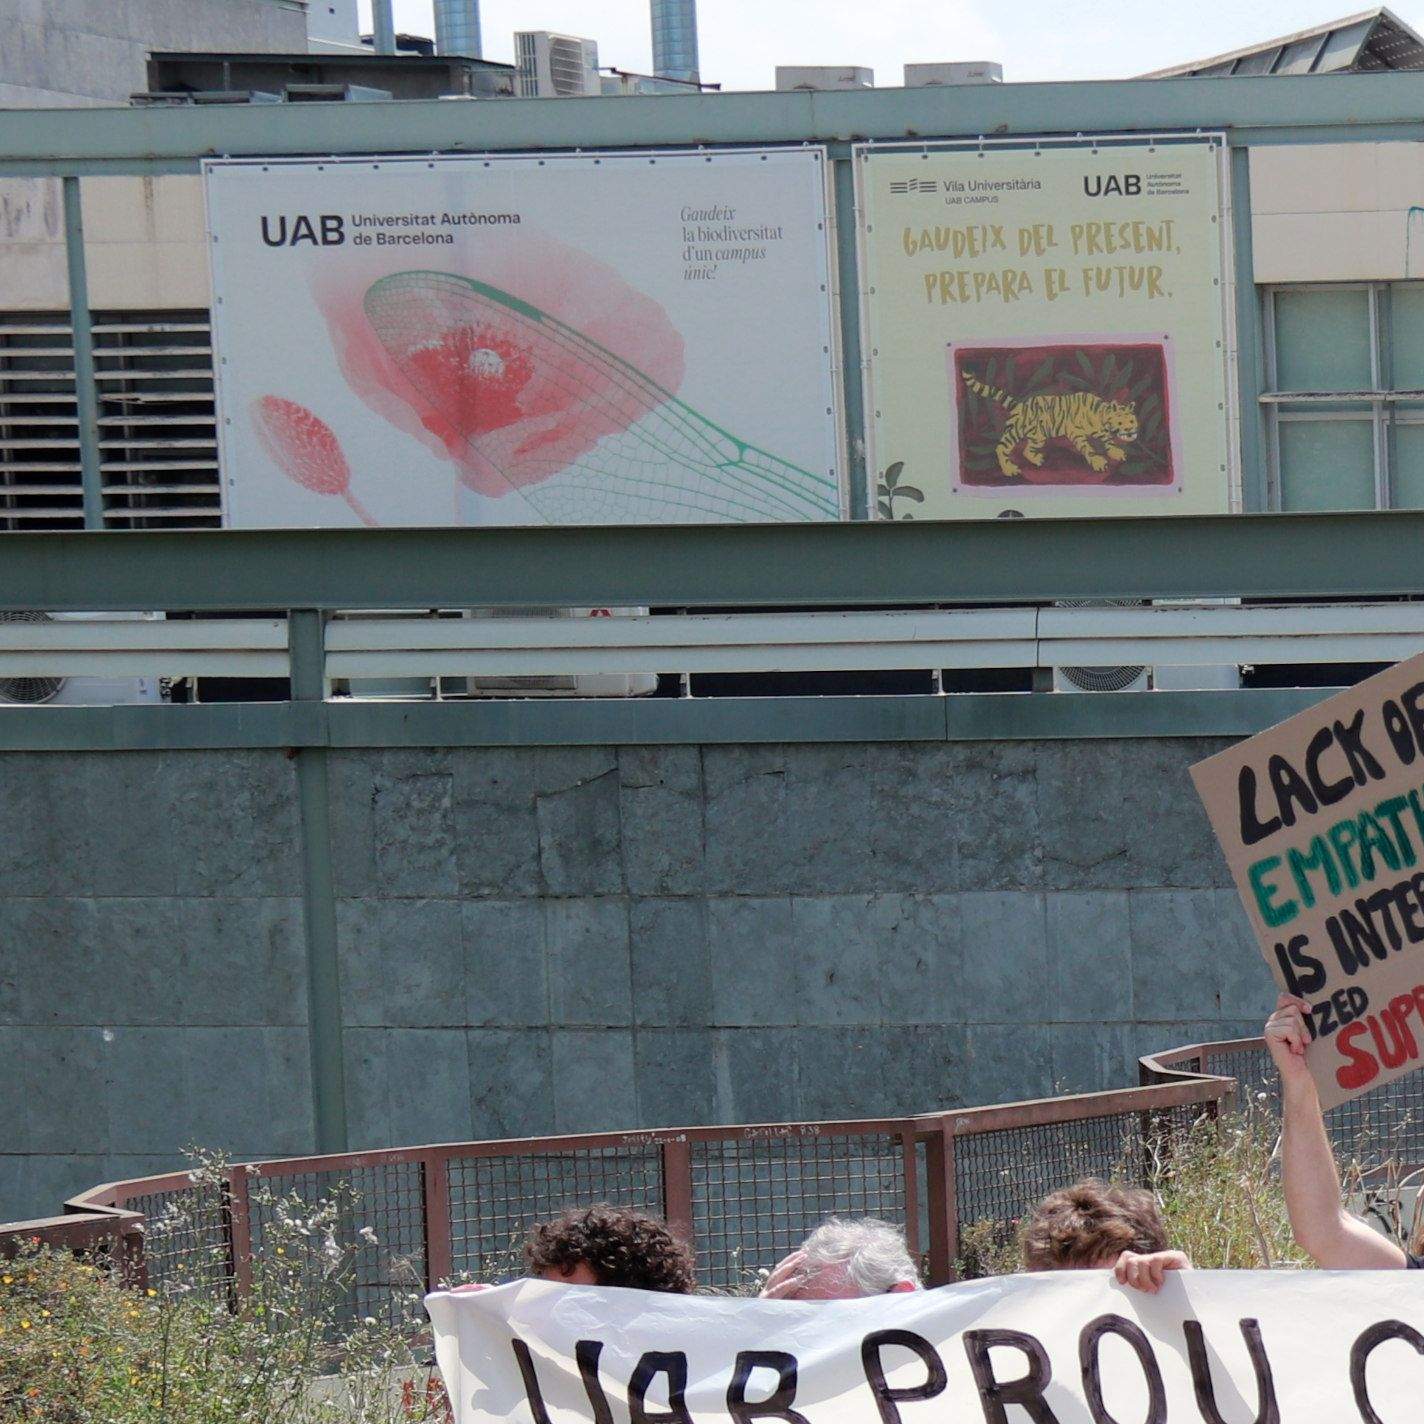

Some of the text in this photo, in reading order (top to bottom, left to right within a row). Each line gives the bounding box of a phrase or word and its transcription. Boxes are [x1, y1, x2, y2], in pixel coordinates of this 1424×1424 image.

[943, 177, 1041, 192] Vila Universitària
[1084, 174, 1141, 197] UAB
[351, 212, 521, 227] Universitat Autònoma
[680, 205, 737, 221] Gaudeix
[261, 215, 345, 247] UAB
[353, 231, 454, 246] de Barcelona
[683, 225, 784, 242] la biodiversitat
[903, 219, 1181, 259] GAUDEIX DEL PRESENT,
[714, 246, 768, 264] campus
[925, 266, 1173, 305] PREPARA EL FUTUR.
[1238, 709, 1386, 846] LACK
[1274, 933, 1327, 1000] IS
